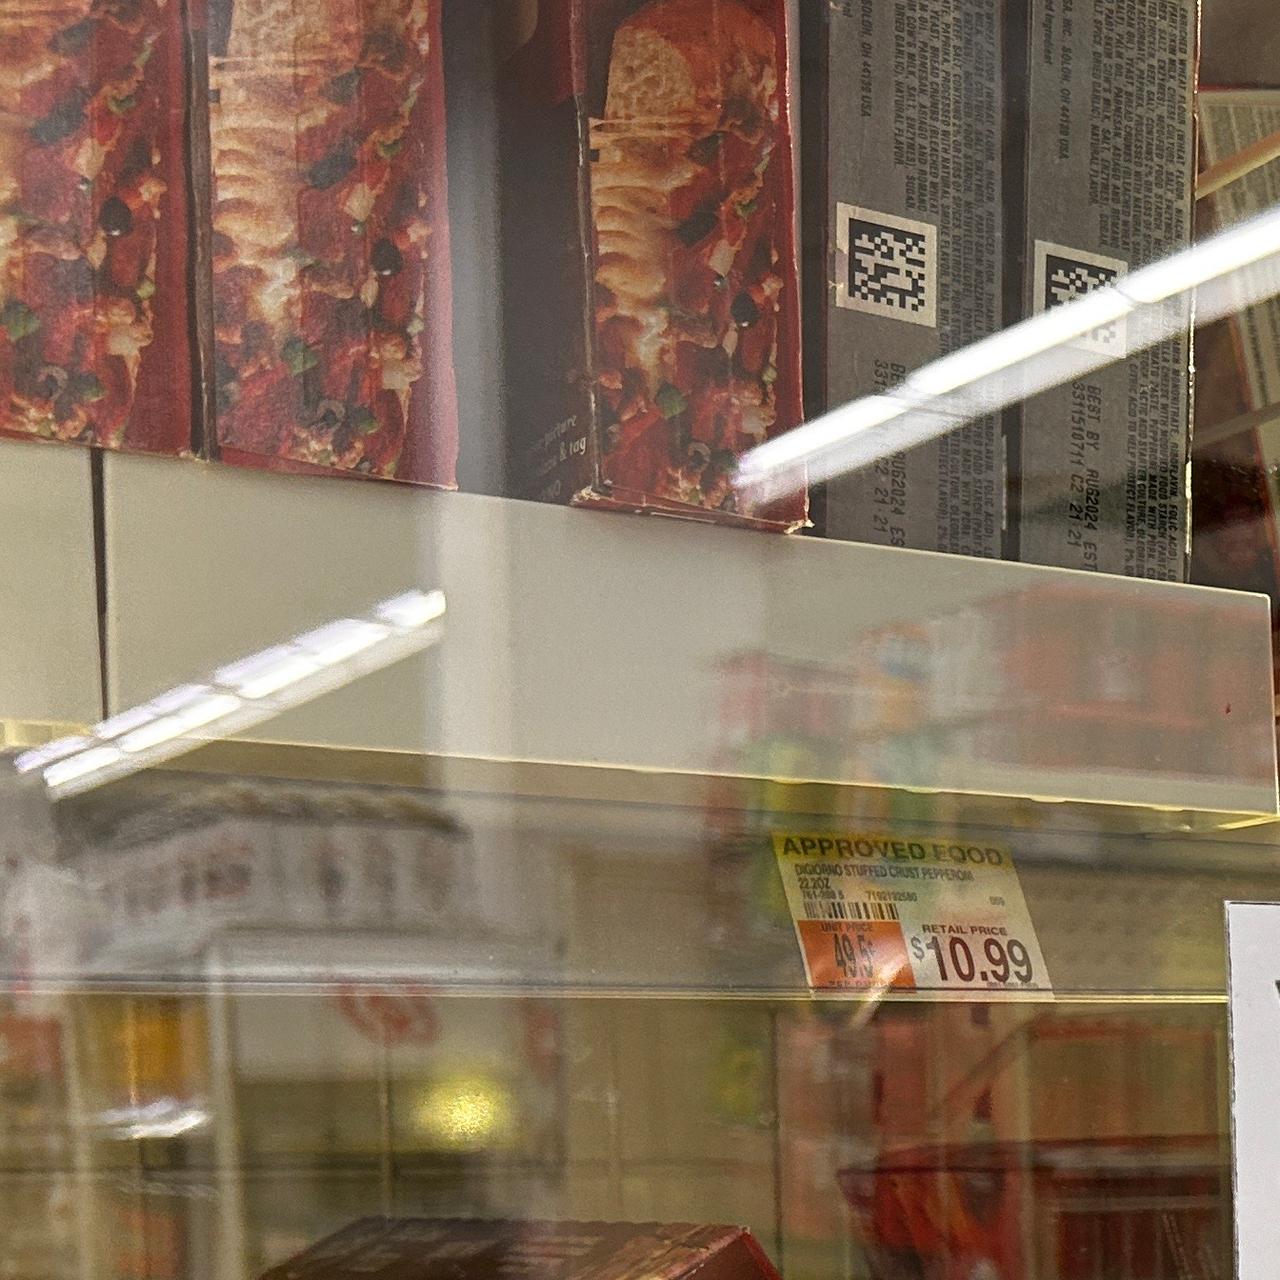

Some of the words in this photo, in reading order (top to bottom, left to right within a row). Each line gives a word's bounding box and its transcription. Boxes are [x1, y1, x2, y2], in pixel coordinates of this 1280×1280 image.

[783, 837, 926, 860] APPROVED
[844, 865, 887, 877] STUFFED
[922, 924, 968, 935] RETAIL
[970, 926, 1008, 936] PRICE
[910, 936, 1033, 983] $10.99
